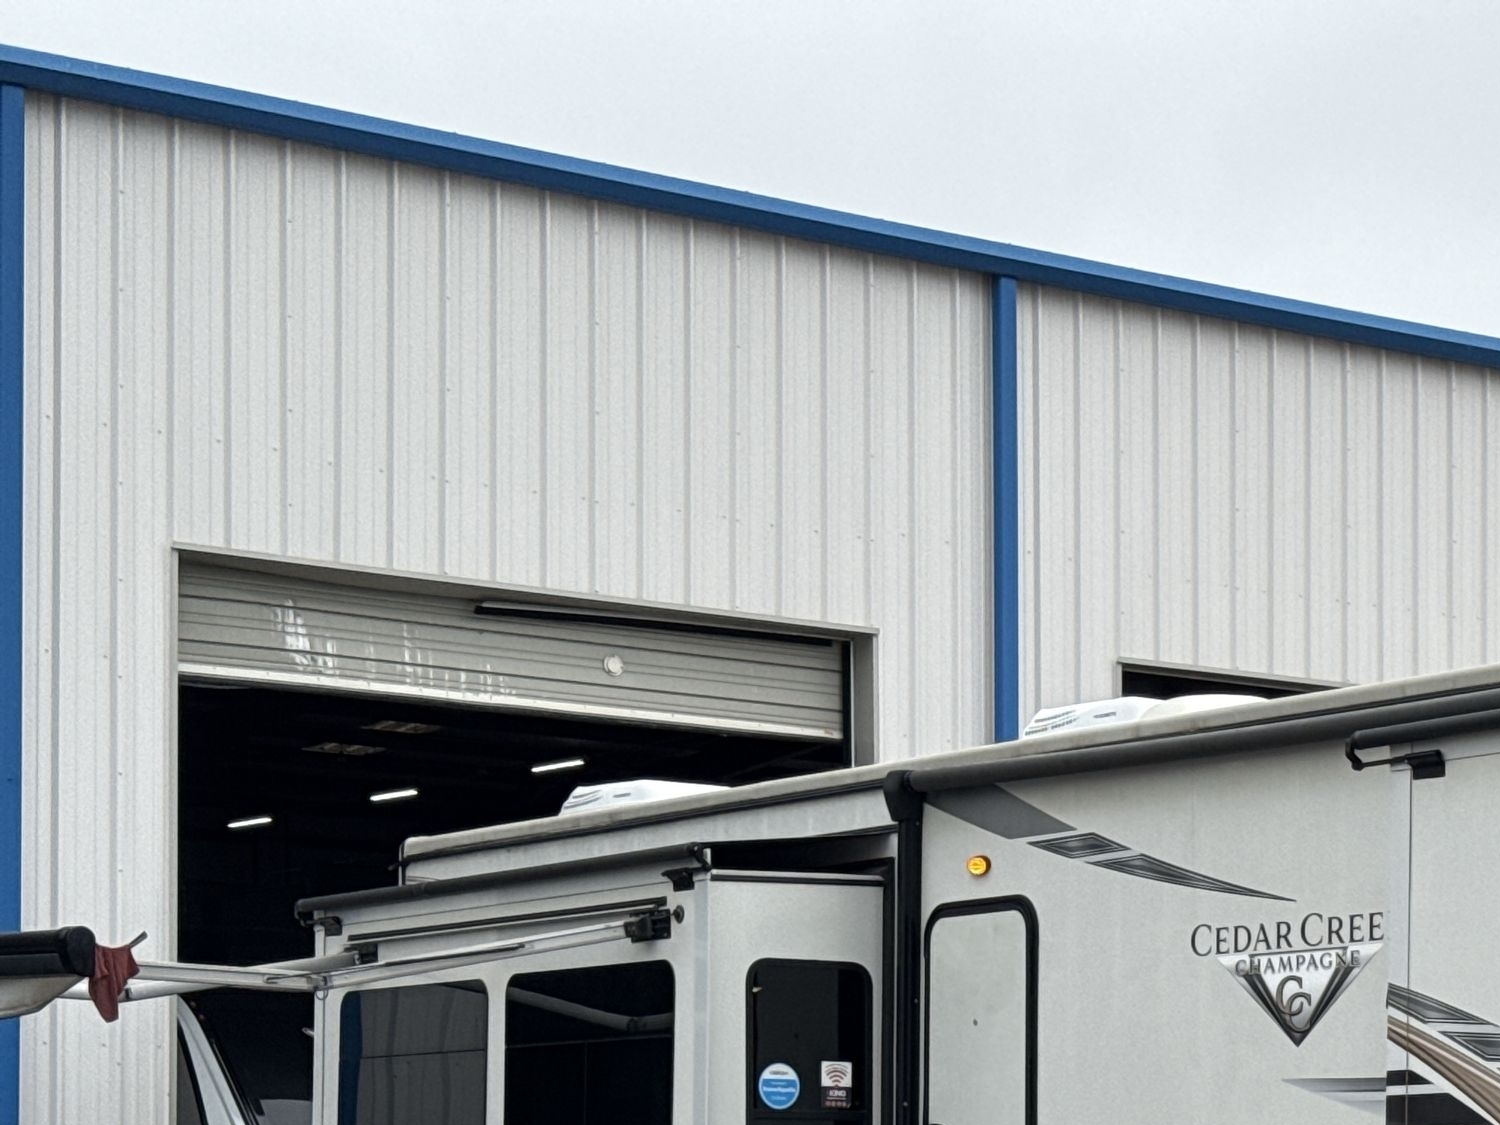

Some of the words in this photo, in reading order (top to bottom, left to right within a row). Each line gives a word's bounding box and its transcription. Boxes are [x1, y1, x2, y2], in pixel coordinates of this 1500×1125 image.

[1190, 920, 1293, 957] CEDAR
[1300, 911, 1385, 947] CREE
[1235, 950, 1361, 977] CHAMPAGNE
